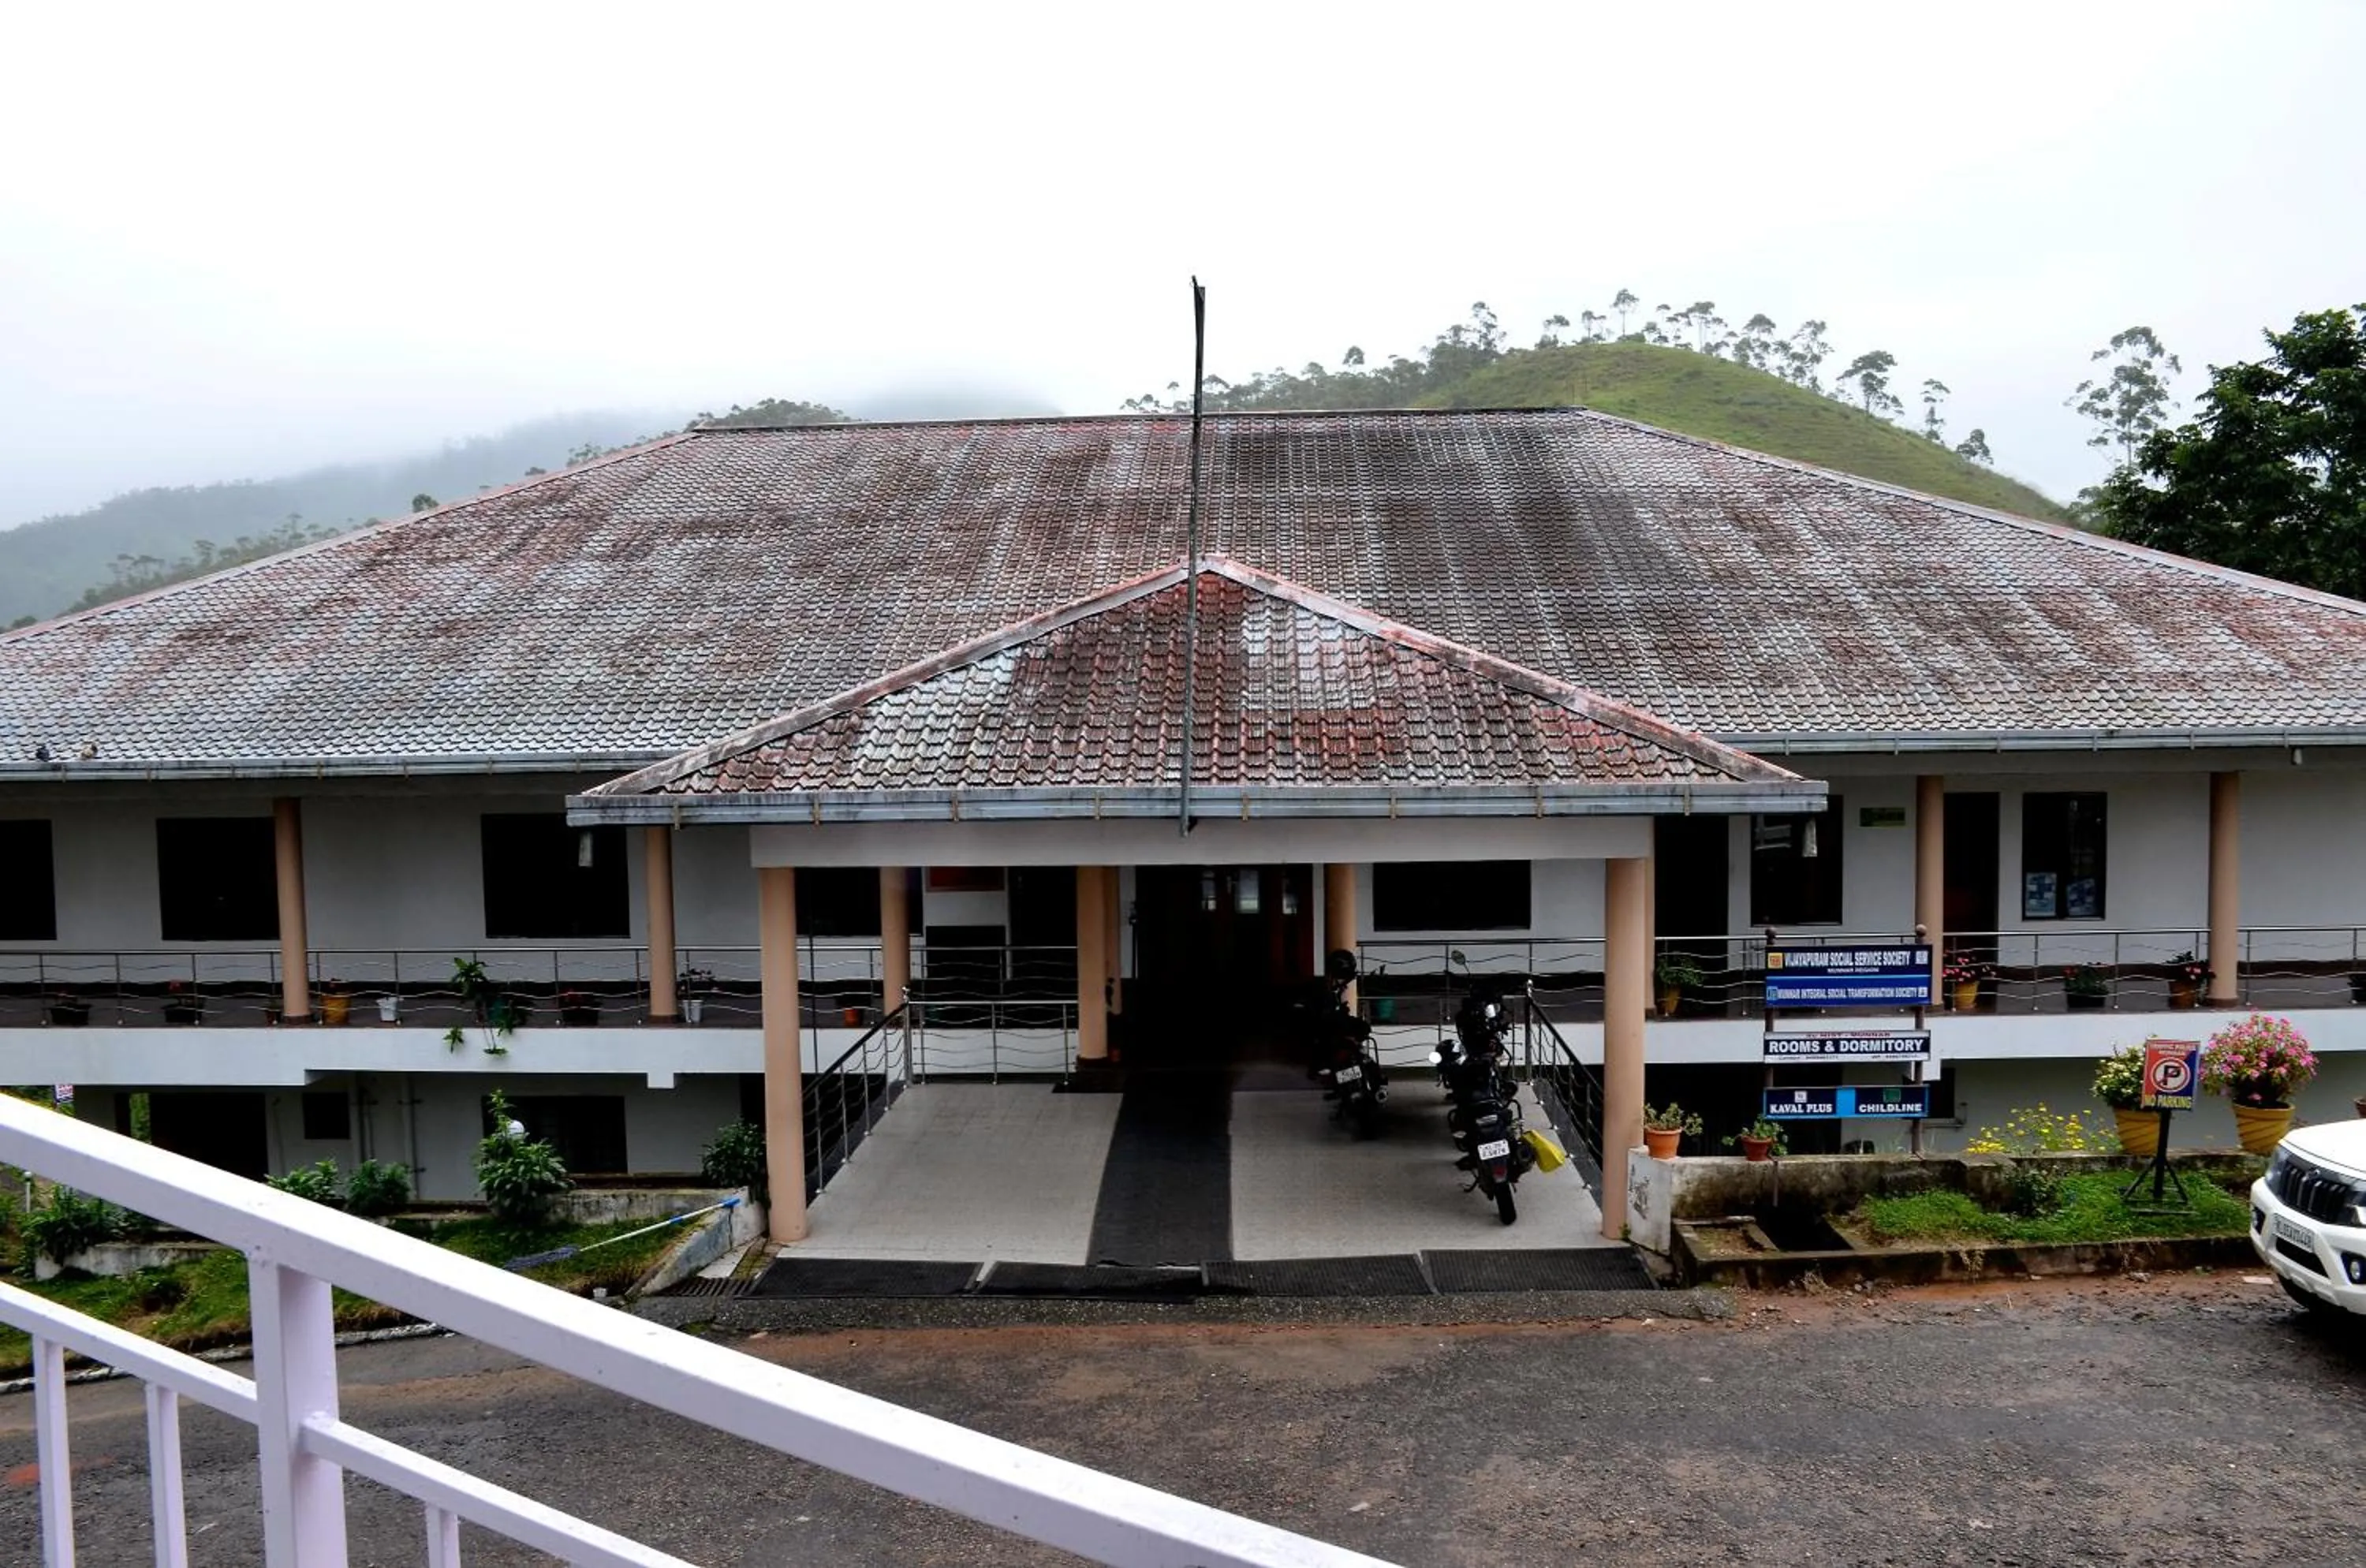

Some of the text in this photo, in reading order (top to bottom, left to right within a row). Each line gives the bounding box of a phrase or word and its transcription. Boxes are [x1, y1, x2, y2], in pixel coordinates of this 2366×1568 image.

[1785, 950, 1910, 967] VIJAYAPURAM SOCIAL SERVICE SOCIETY
[1801, 988, 1827, 999] INTEGRAL
[1827, 988, 1847, 999] SOCIAL
[1847, 987, 1894, 999] TRANSFORMATION
[1895, 987, 1916, 998] SOCIETY
[1769, 1039, 1924, 1053] ROOMS & DORMITORY
[2144, 1094, 2192, 1109] NO PARKING
[1770, 1103, 1833, 1114] KAVAL PLUS
[1858, 1103, 1922, 1114] CHILDLINE
